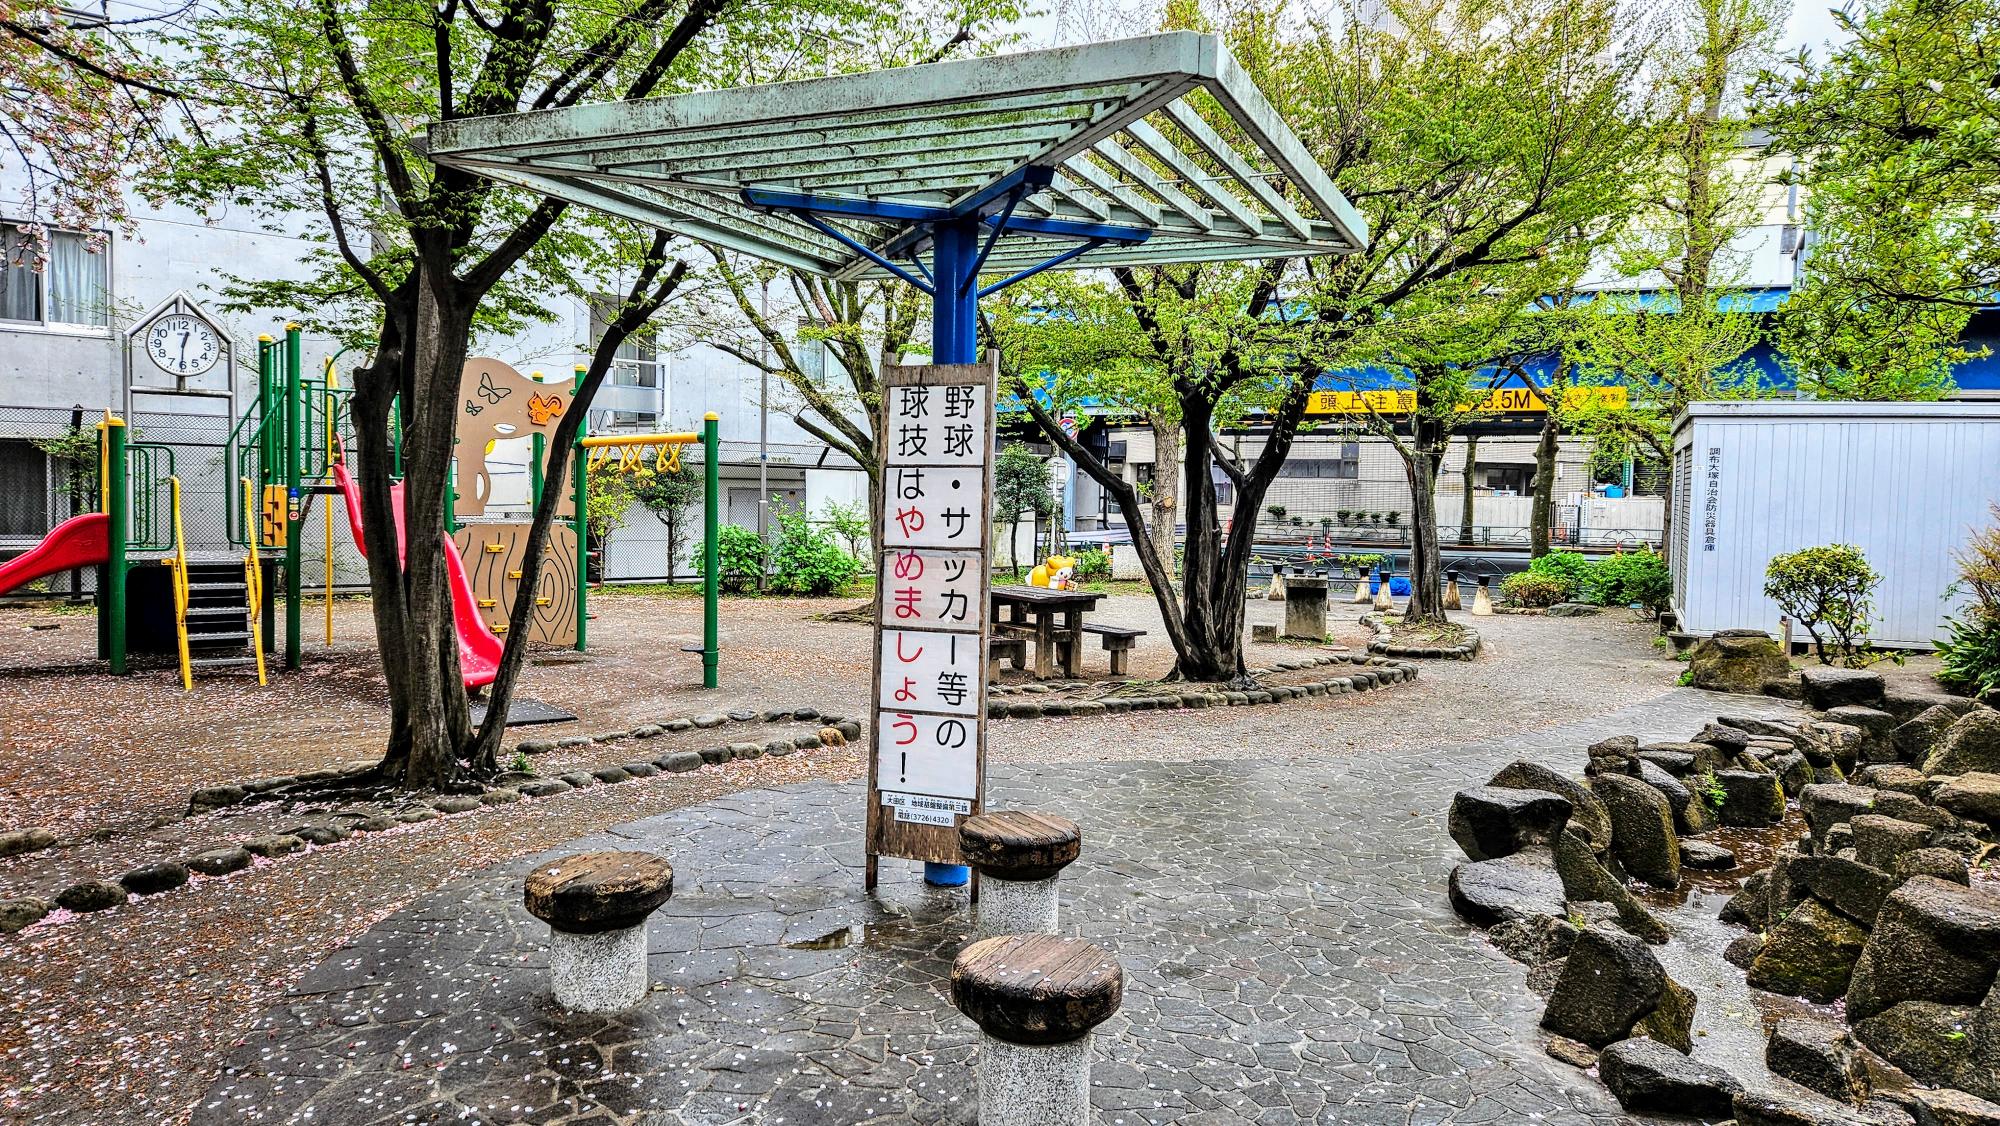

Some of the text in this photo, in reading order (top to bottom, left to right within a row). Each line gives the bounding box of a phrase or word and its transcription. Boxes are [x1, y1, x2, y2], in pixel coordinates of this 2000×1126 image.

[167, 321, 176, 331] 11
[178, 320, 189, 330] 12
[157, 328, 168, 338] 10
[200, 331, 208, 340] 2
[154, 338, 162, 348] 9
[203, 342, 212, 352] 3
[158, 348, 167, 358] 8
[199, 352, 208, 361] 4
[167, 357, 176, 366] 7
[179, 360, 187, 370] 6
[191, 358, 199, 368] 5
[1320, 393, 1414, 411] 頭上注意
[1704, 447, 1721, 552] 調布大塚自治会防災器具倉庫
[936, 386, 975, 749] 野球・サッカー等の
[892, 386, 930, 783] 球技はやめましょう！
